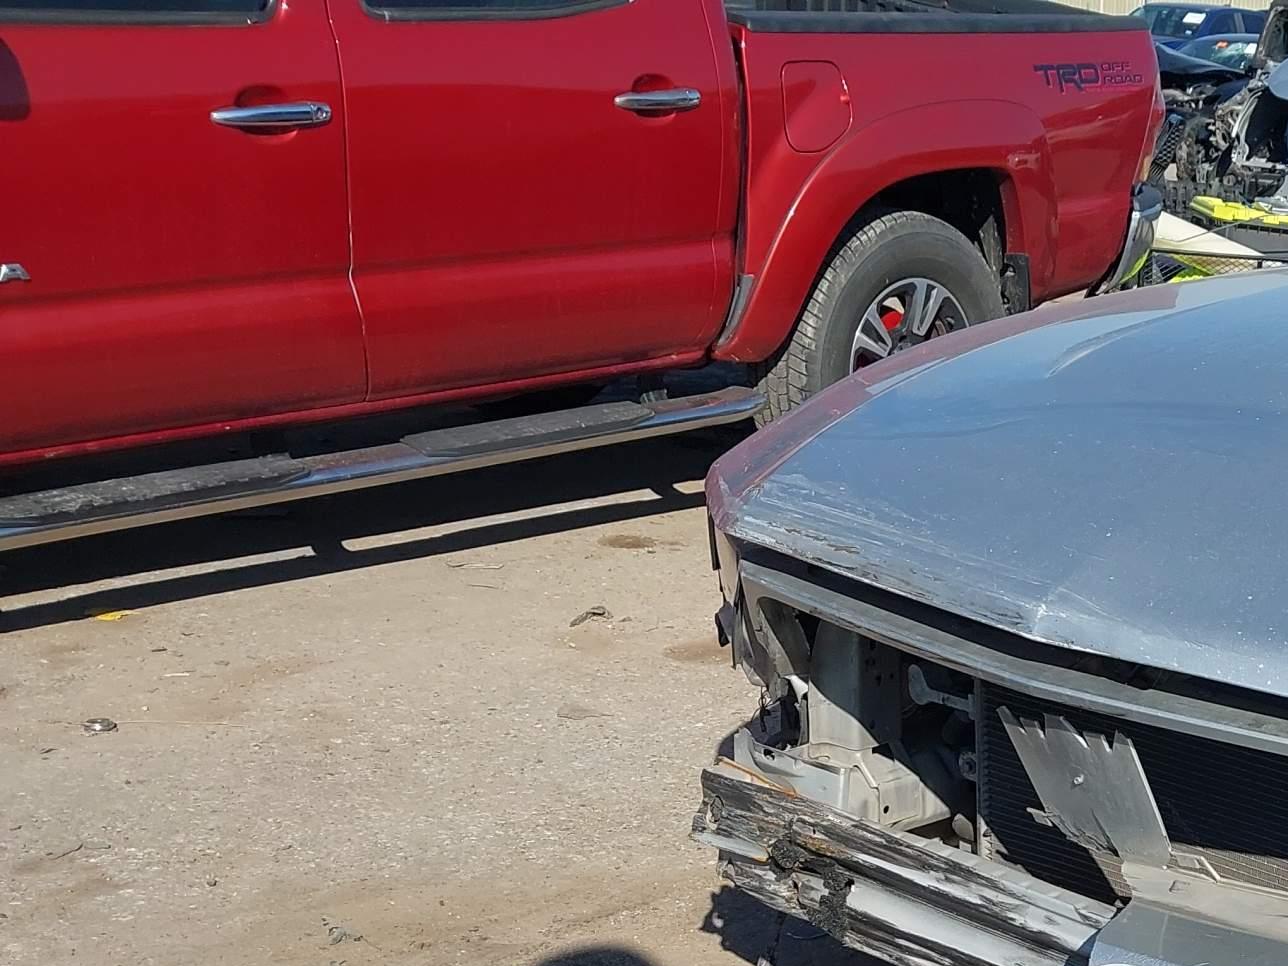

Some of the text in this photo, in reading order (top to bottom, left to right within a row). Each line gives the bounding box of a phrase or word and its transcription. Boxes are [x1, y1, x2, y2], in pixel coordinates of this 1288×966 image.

[1101, 62, 1131, 73] OFF
[1033, 63, 1100, 93] TRD
[1104, 74, 1144, 85] ROAD
